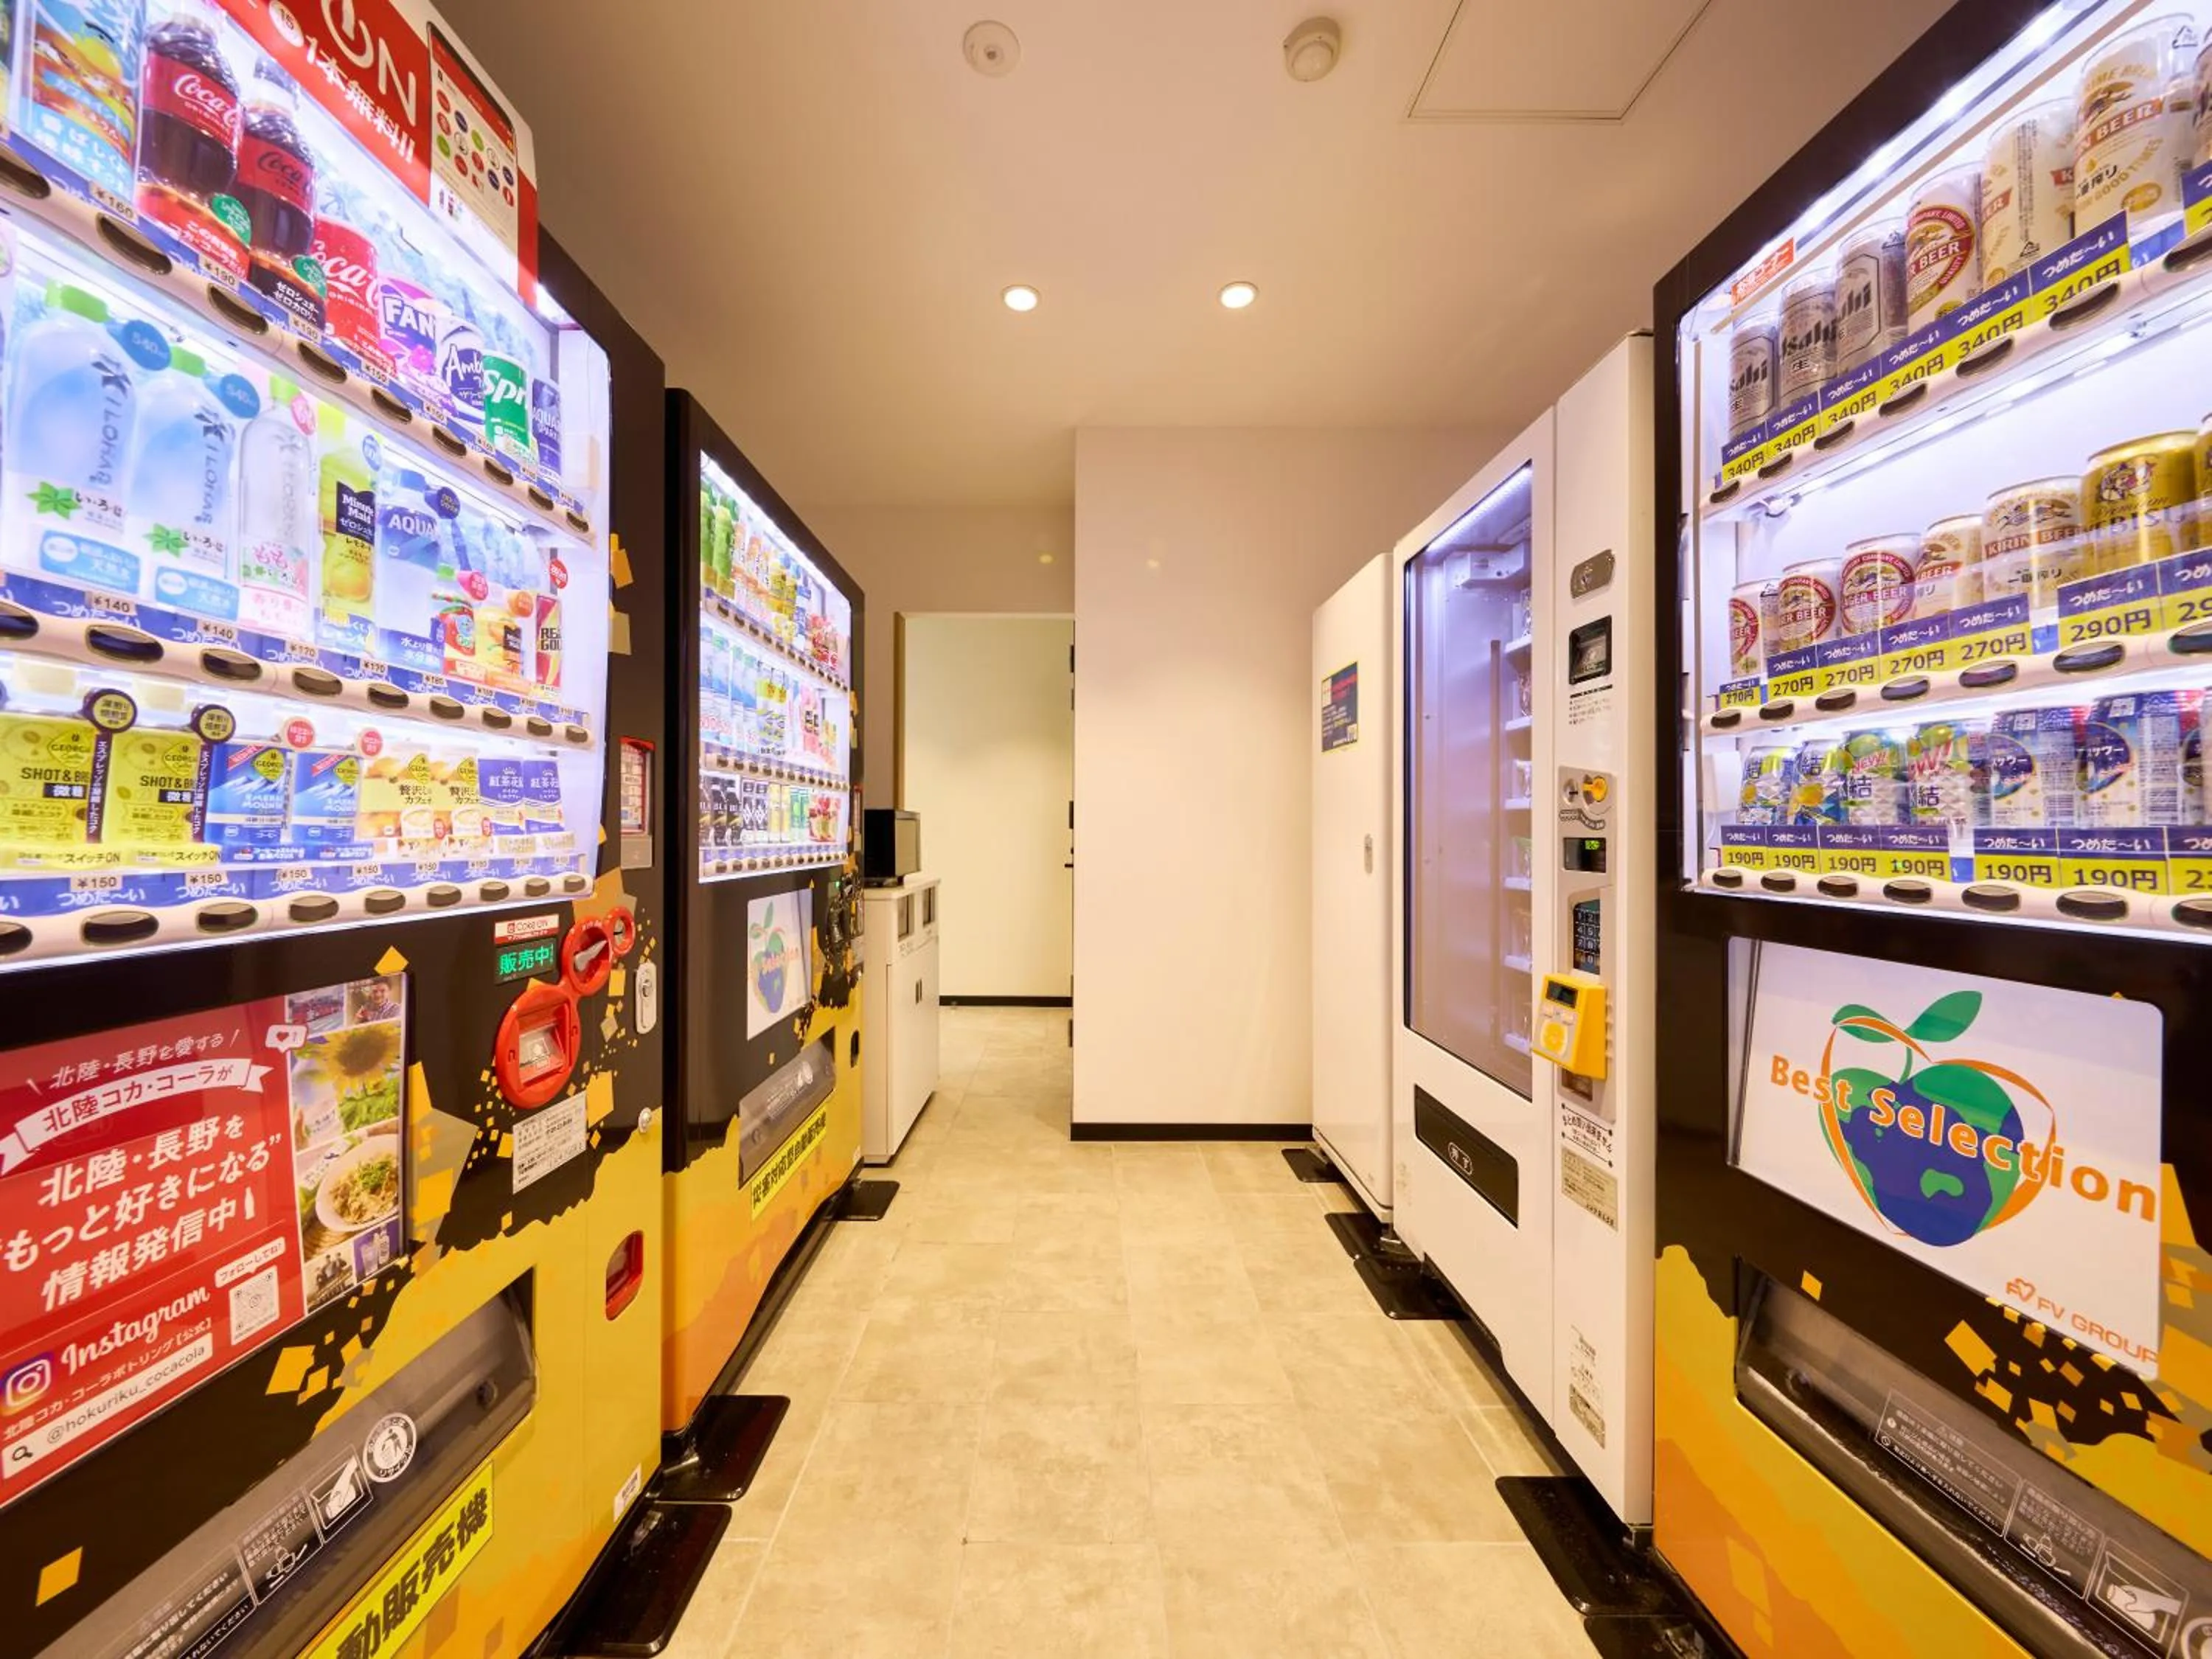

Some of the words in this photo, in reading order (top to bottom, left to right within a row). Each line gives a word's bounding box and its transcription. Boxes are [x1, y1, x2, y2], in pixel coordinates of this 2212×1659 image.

[2096, 103, 2154, 141] BEER
[1919, 241, 1961, 269] BEER
[2043, 258, 2121, 316] 340円
[1958, 311, 2024, 359] 340円
[1889, 354, 1944, 390] 340円
[1827, 391, 1877, 425] 340円
[1773, 423, 1815, 453] 340円
[1873, 586, 1907, 601] BEER
[1795, 607, 1827, 621] BEER
[2070, 608, 2152, 643] 290円
[1961, 632, 2027, 661] 270円
[1825, 664, 1876, 686] 270円
[1889, 649, 1944, 675] 270円
[1773, 675, 1814, 697] 270円
[21, 768, 60, 781] SHOT
[62, 769, 72, 782] &
[140, 775, 173, 787] SHOT
[1728, 852, 1764, 866] 190円
[1774, 854, 1816, 870] 190円
[1829, 857, 1877, 873] 190円
[1891, 859, 1945, 876] 190円
[1985, 863, 2053, 883] 190円
[77, 876, 117, 889] ¥150
[189, 873, 222, 885] ¥150
[2073, 868, 2158, 891] 190円
[48, 1032, 226, 1091] 北陸・長野を愛する
[43, 1063, 236, 1133] 北陸コカ・コーラが
[1770, 1055, 1851, 1111] Best
[1869, 1088, 2157, 1222] Selection
[38, 1114, 245, 1208] 北陸・長野を
[61, 1285, 211, 1376] Instagram
[2070, 1313, 2159, 1366] GROUP
[46, 1345, 206, 1445] @hokuriku_cocacola
